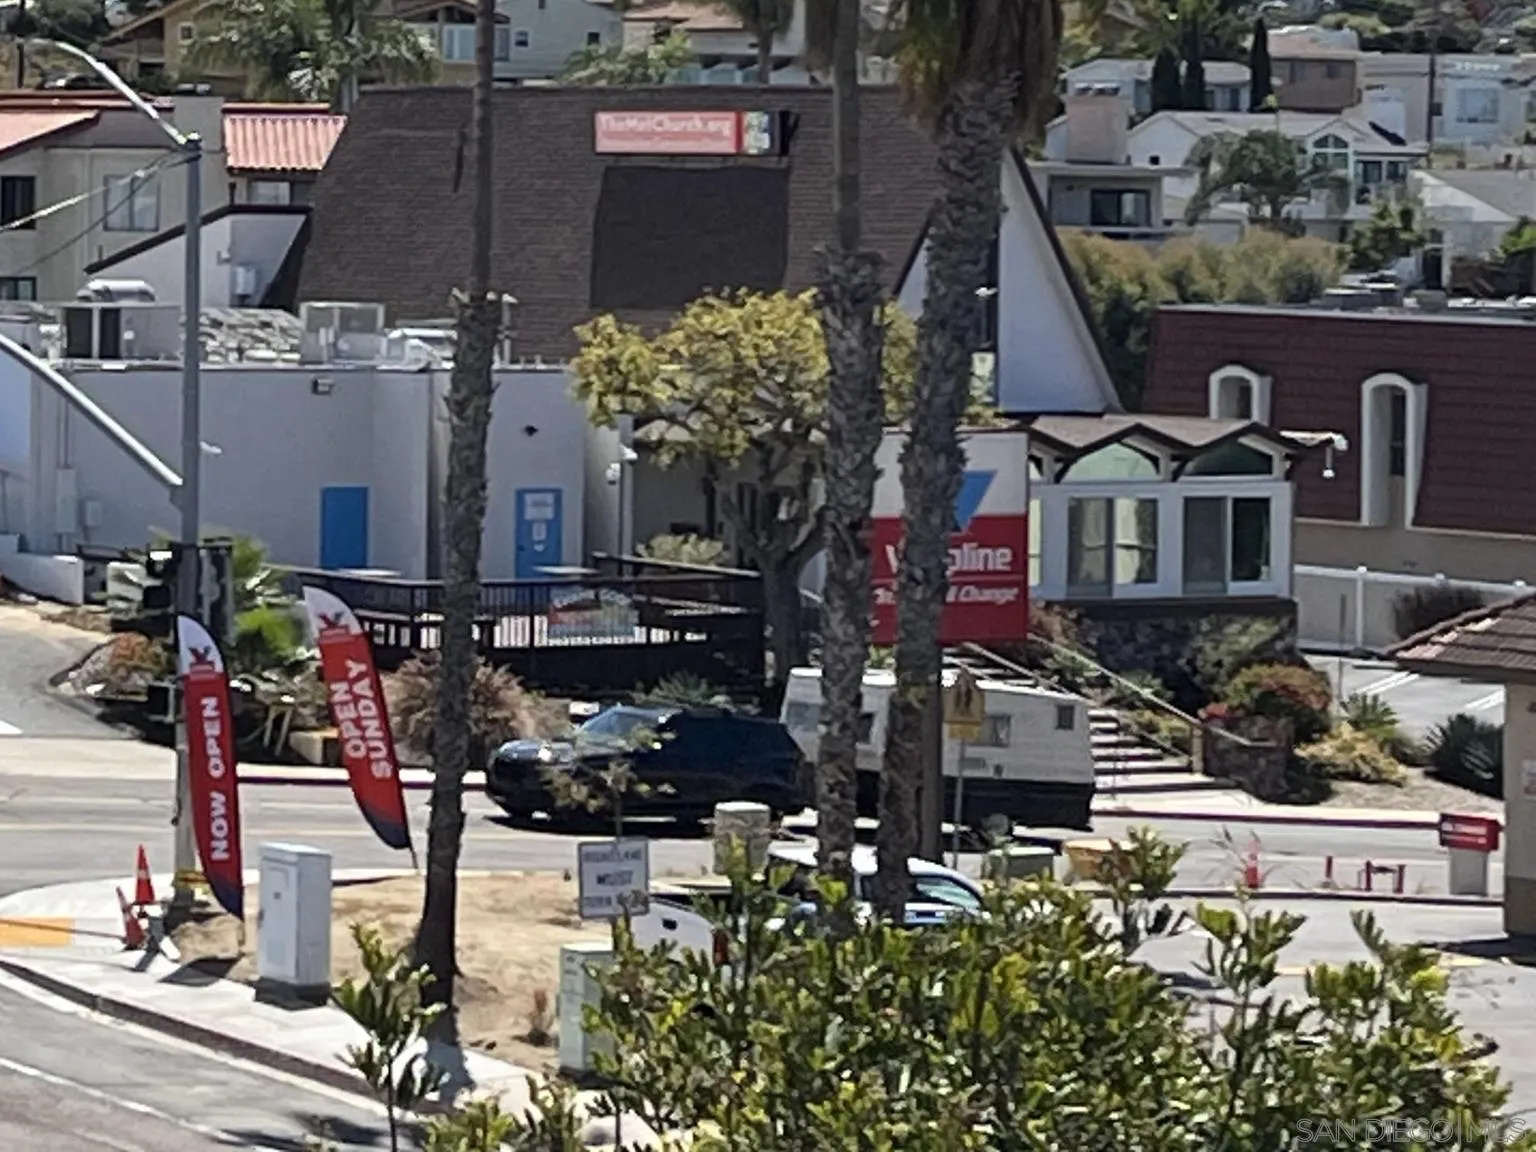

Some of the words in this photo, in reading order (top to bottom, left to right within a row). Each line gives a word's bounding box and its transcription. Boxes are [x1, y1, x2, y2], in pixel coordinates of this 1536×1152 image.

[962, 585, 1019, 605] Change
[200, 696, 225, 779] OPEN
[330, 681, 367, 759] OPEN
[345, 659, 393, 779] SUNDAY
[210, 791, 230, 861] NOW
